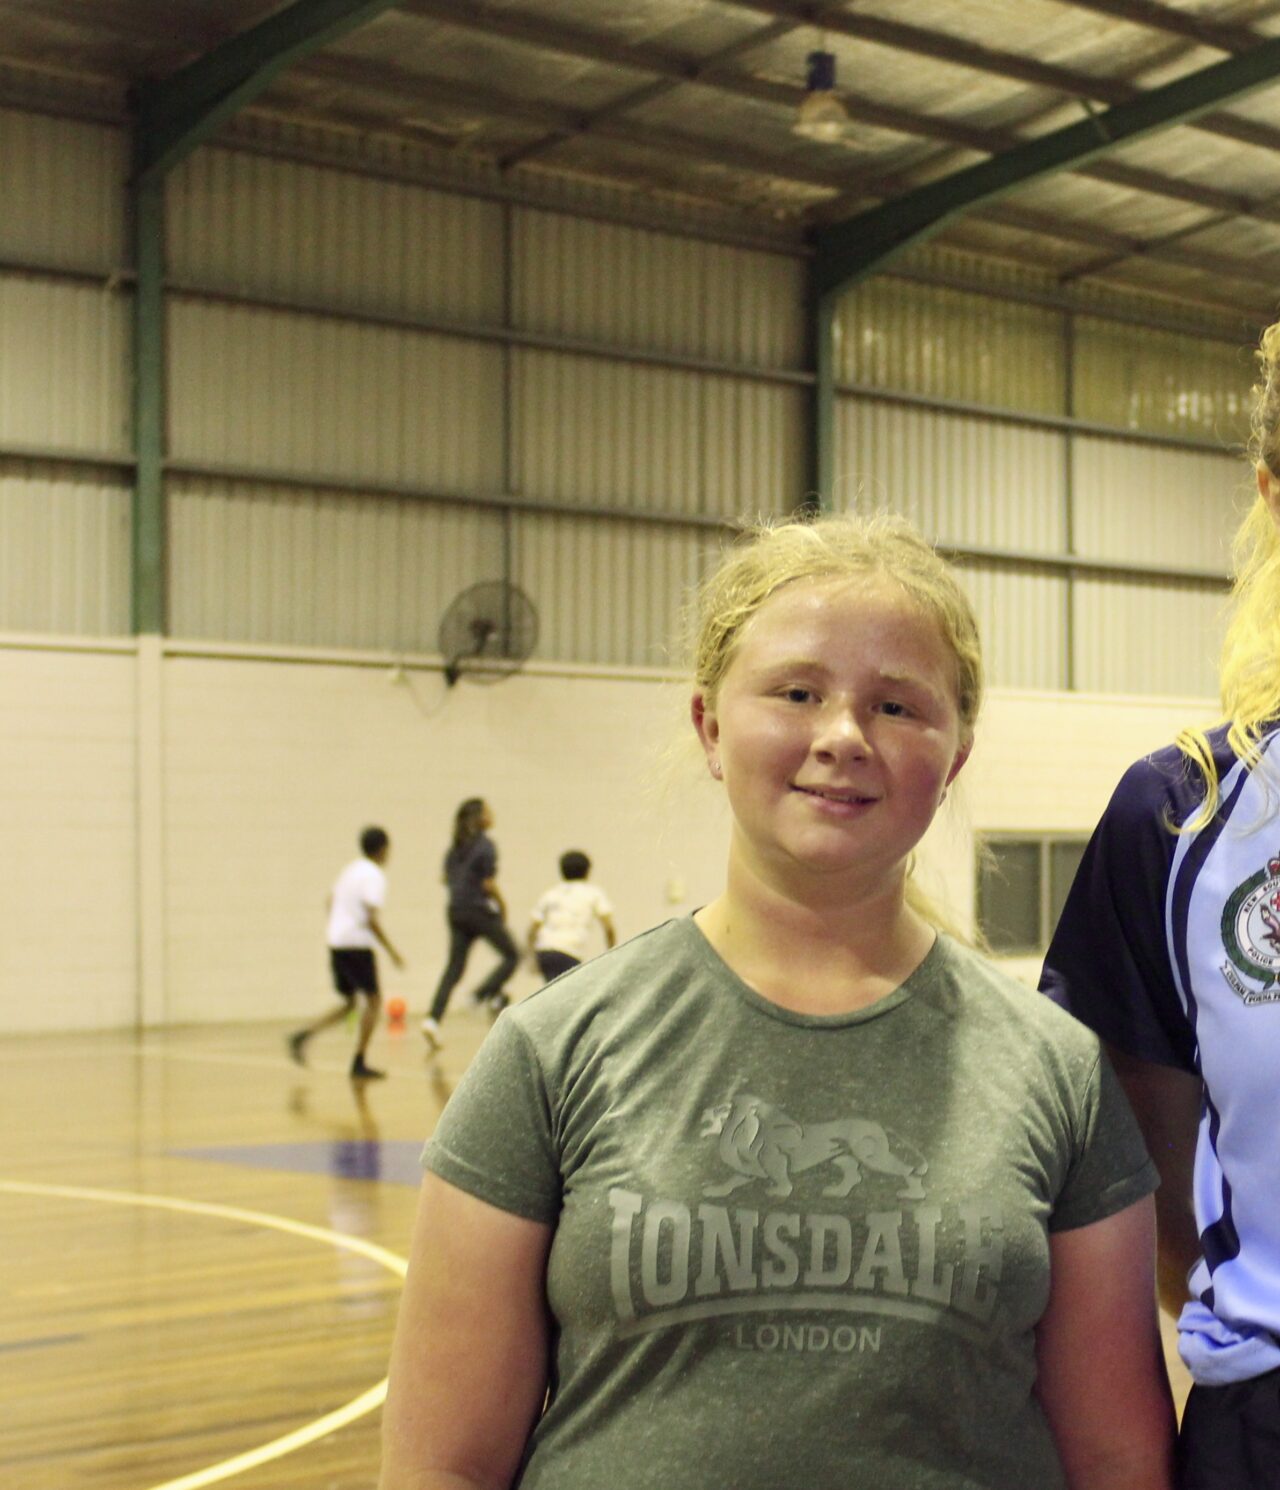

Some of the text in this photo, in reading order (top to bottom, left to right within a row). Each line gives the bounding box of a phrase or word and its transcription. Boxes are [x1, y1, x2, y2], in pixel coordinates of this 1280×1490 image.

[1244, 896, 1257, 913] NEW
[1247, 948, 1273, 965] POLICE
[609, 1188, 1004, 1322] LONSDALE
[736, 1323, 882, 1353] LONDON
